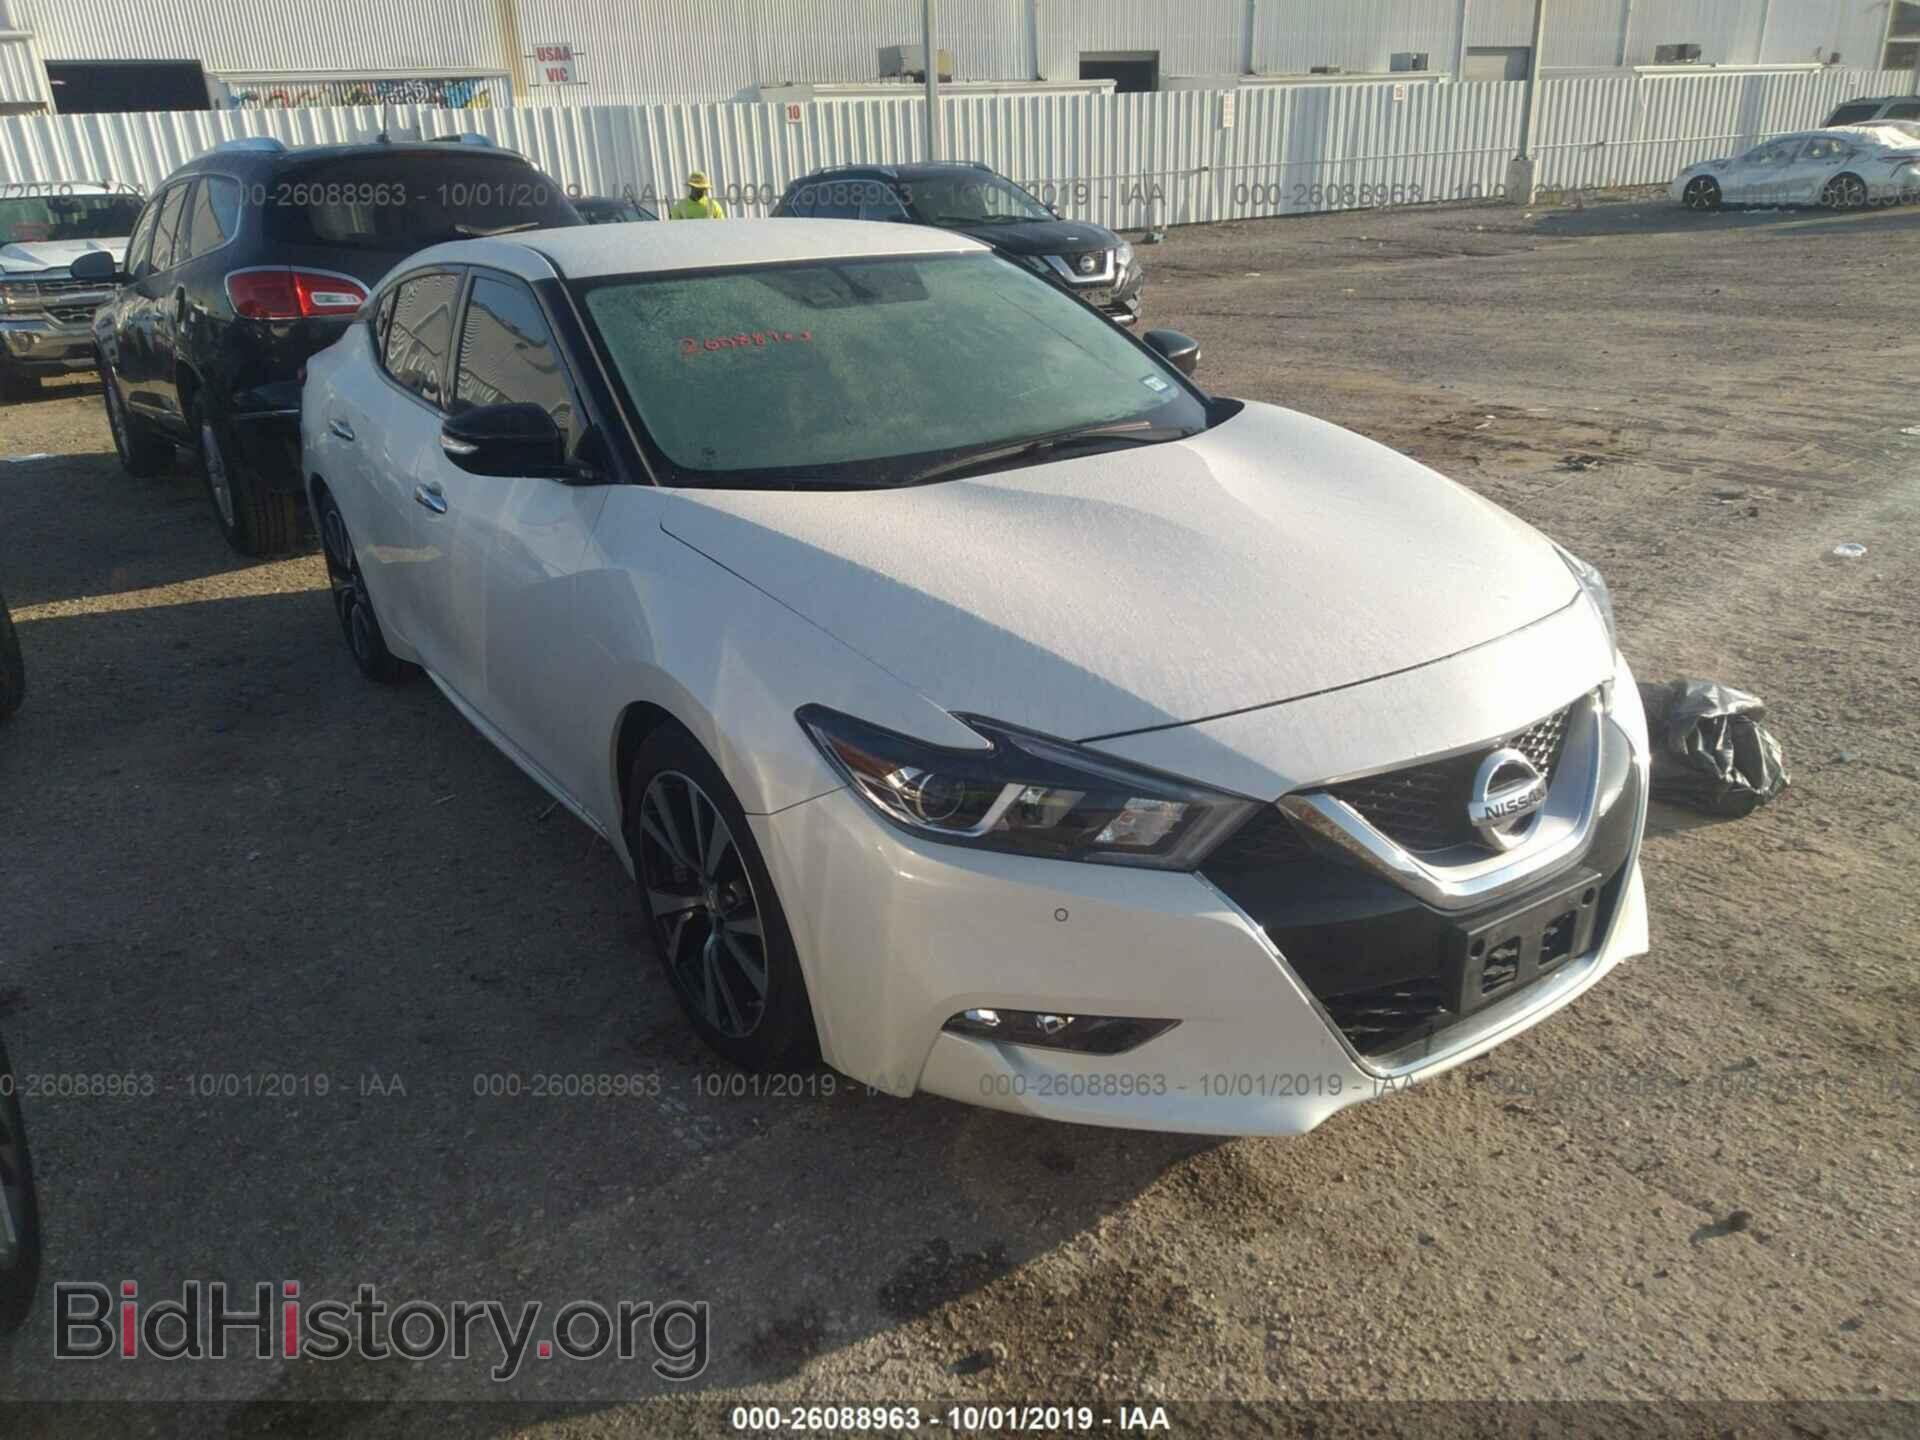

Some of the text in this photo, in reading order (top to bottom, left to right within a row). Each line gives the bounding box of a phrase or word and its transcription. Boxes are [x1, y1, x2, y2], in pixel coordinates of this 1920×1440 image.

[536, 46, 571, 61] USAA
[545, 67, 568, 82] VIC
[787, 104, 800, 120] 10
